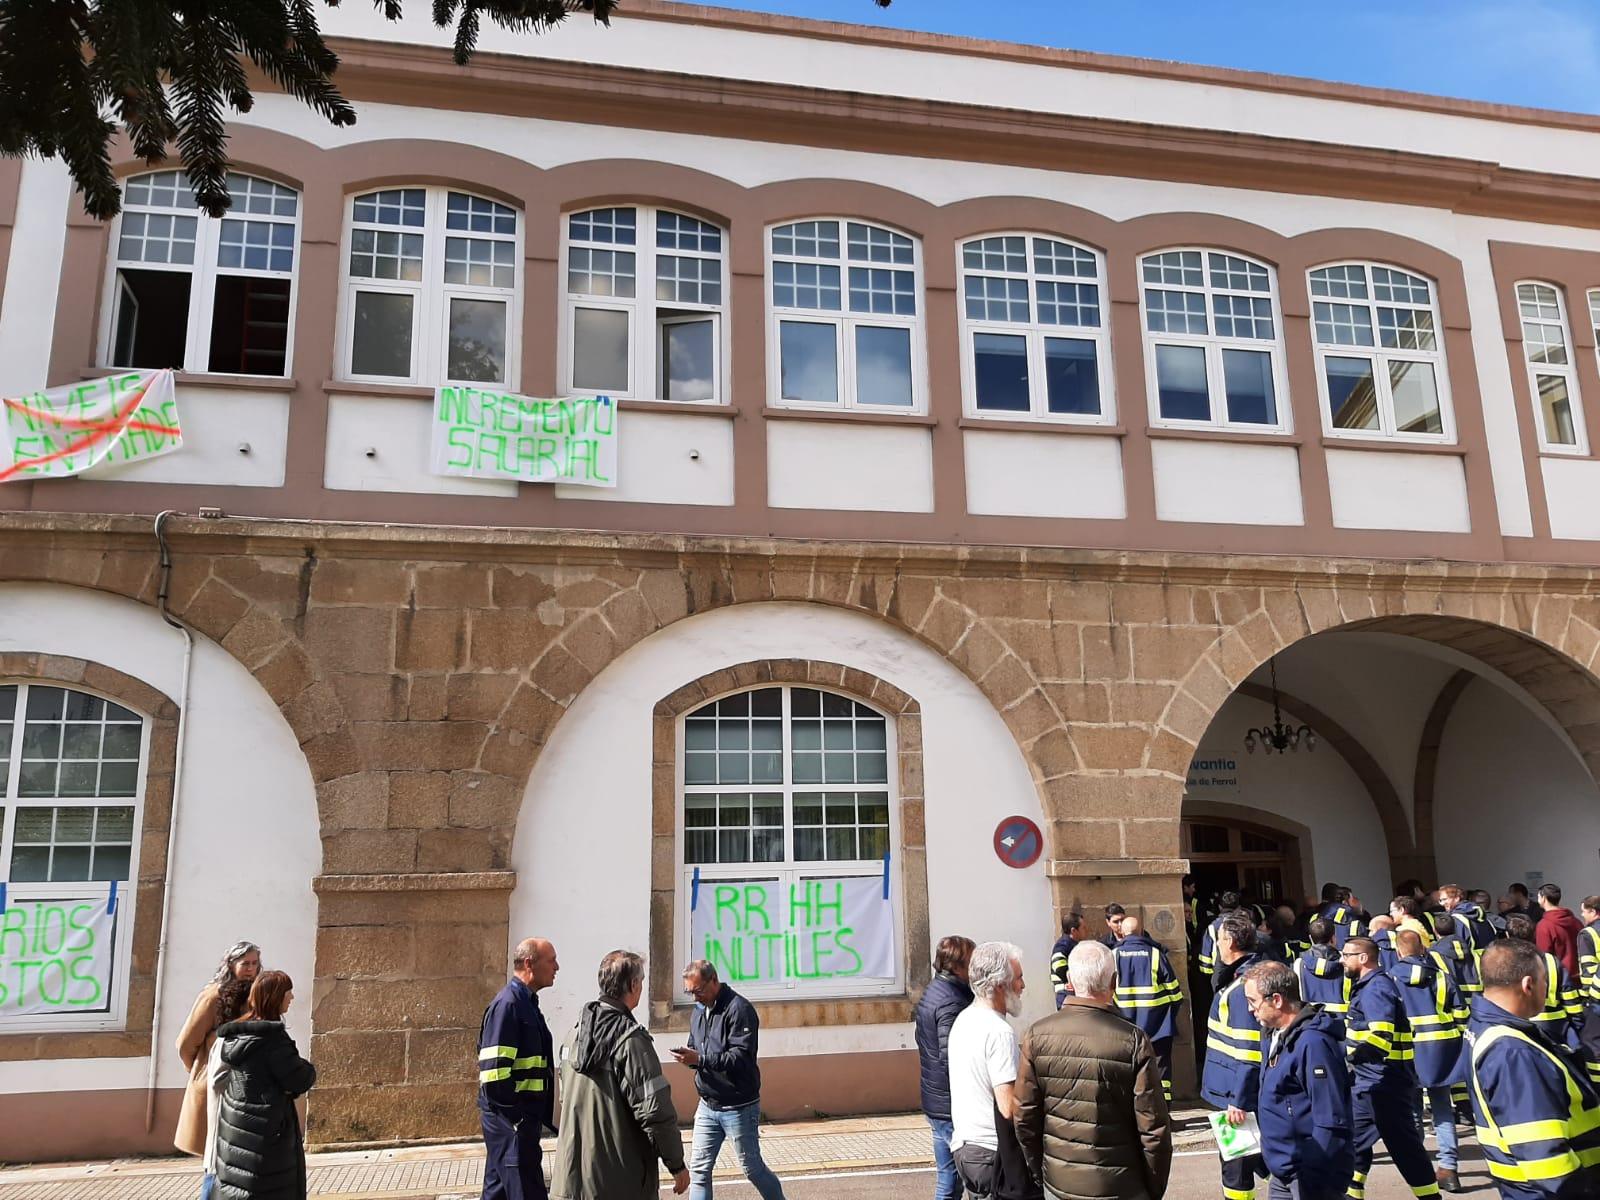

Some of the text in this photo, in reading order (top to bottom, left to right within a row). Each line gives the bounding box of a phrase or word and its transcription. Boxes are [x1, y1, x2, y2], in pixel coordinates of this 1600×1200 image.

[1190, 759, 1236, 770] vantia
[1212, 777, 1237, 786] Ferrol
[715, 881, 842, 932] RR HH
